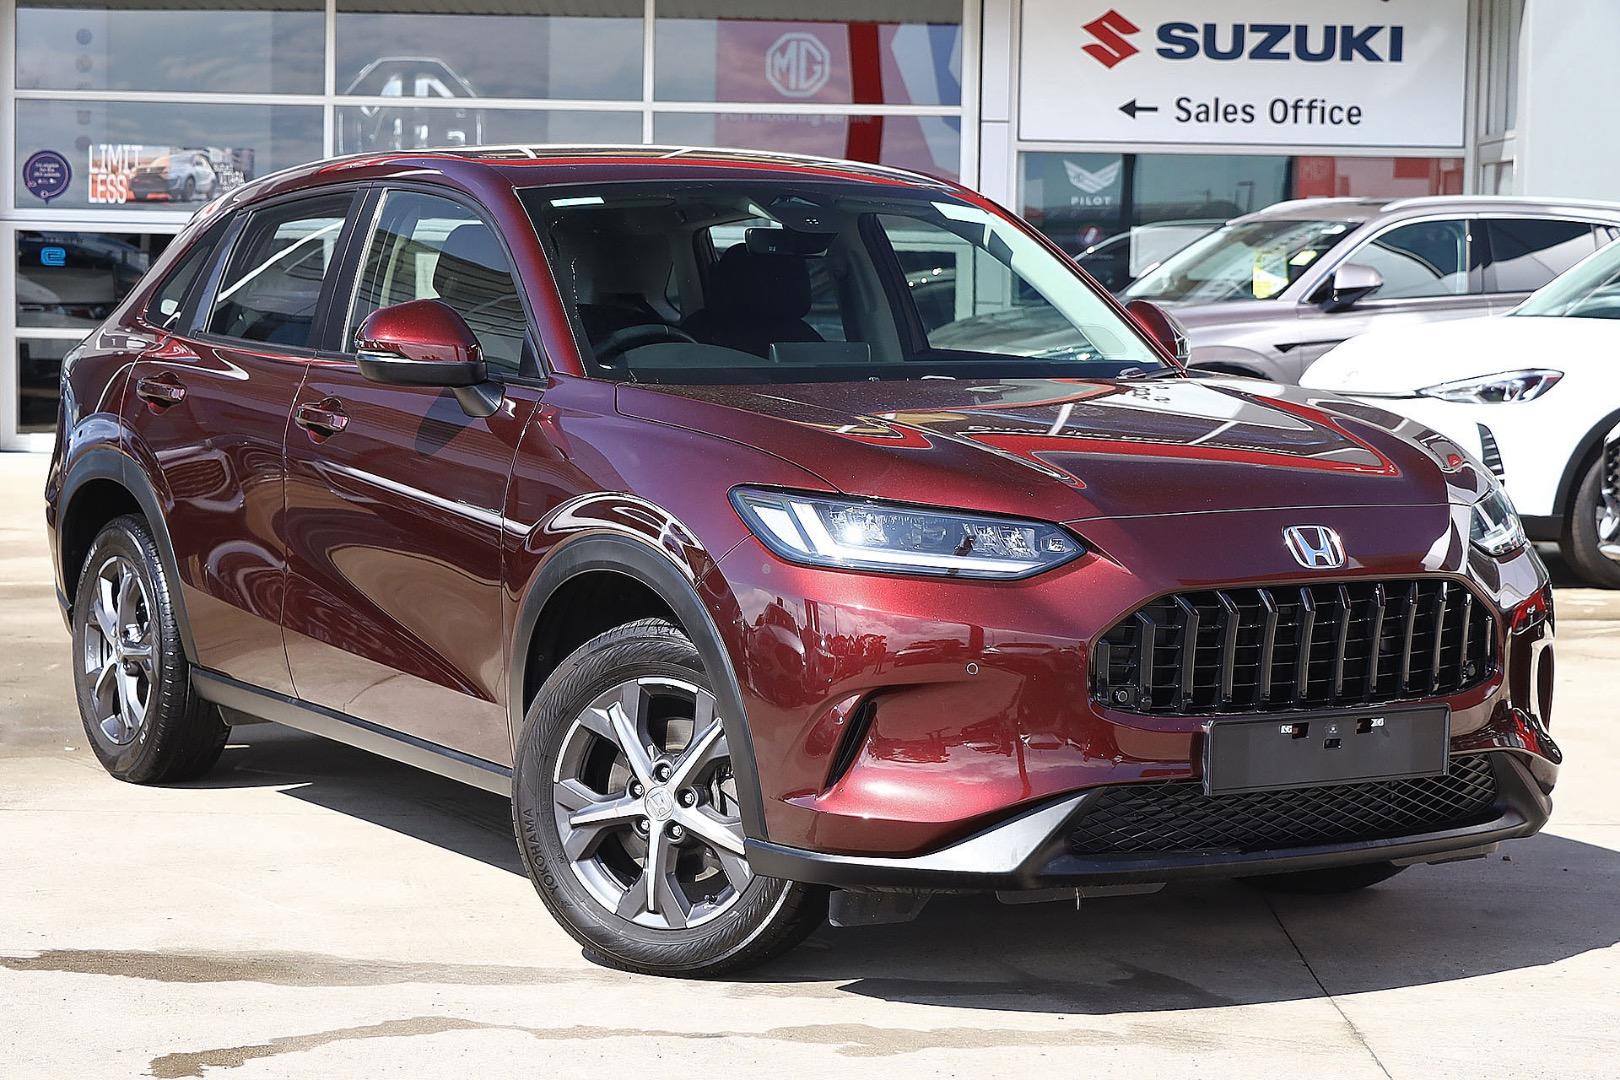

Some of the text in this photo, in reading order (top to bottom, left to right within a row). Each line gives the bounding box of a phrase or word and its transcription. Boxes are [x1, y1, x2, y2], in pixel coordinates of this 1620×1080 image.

[1155, 22, 1404, 63] SUZUKI
[772, 40, 822, 90] MG
[1175, 97, 1362, 125] Sales Office
[88, 144, 143, 174] LIMIT
[88, 174, 128, 204] LESS
[1070, 196, 1112, 206] PILOT
[522, 808, 559, 895] YOKOHAMA
